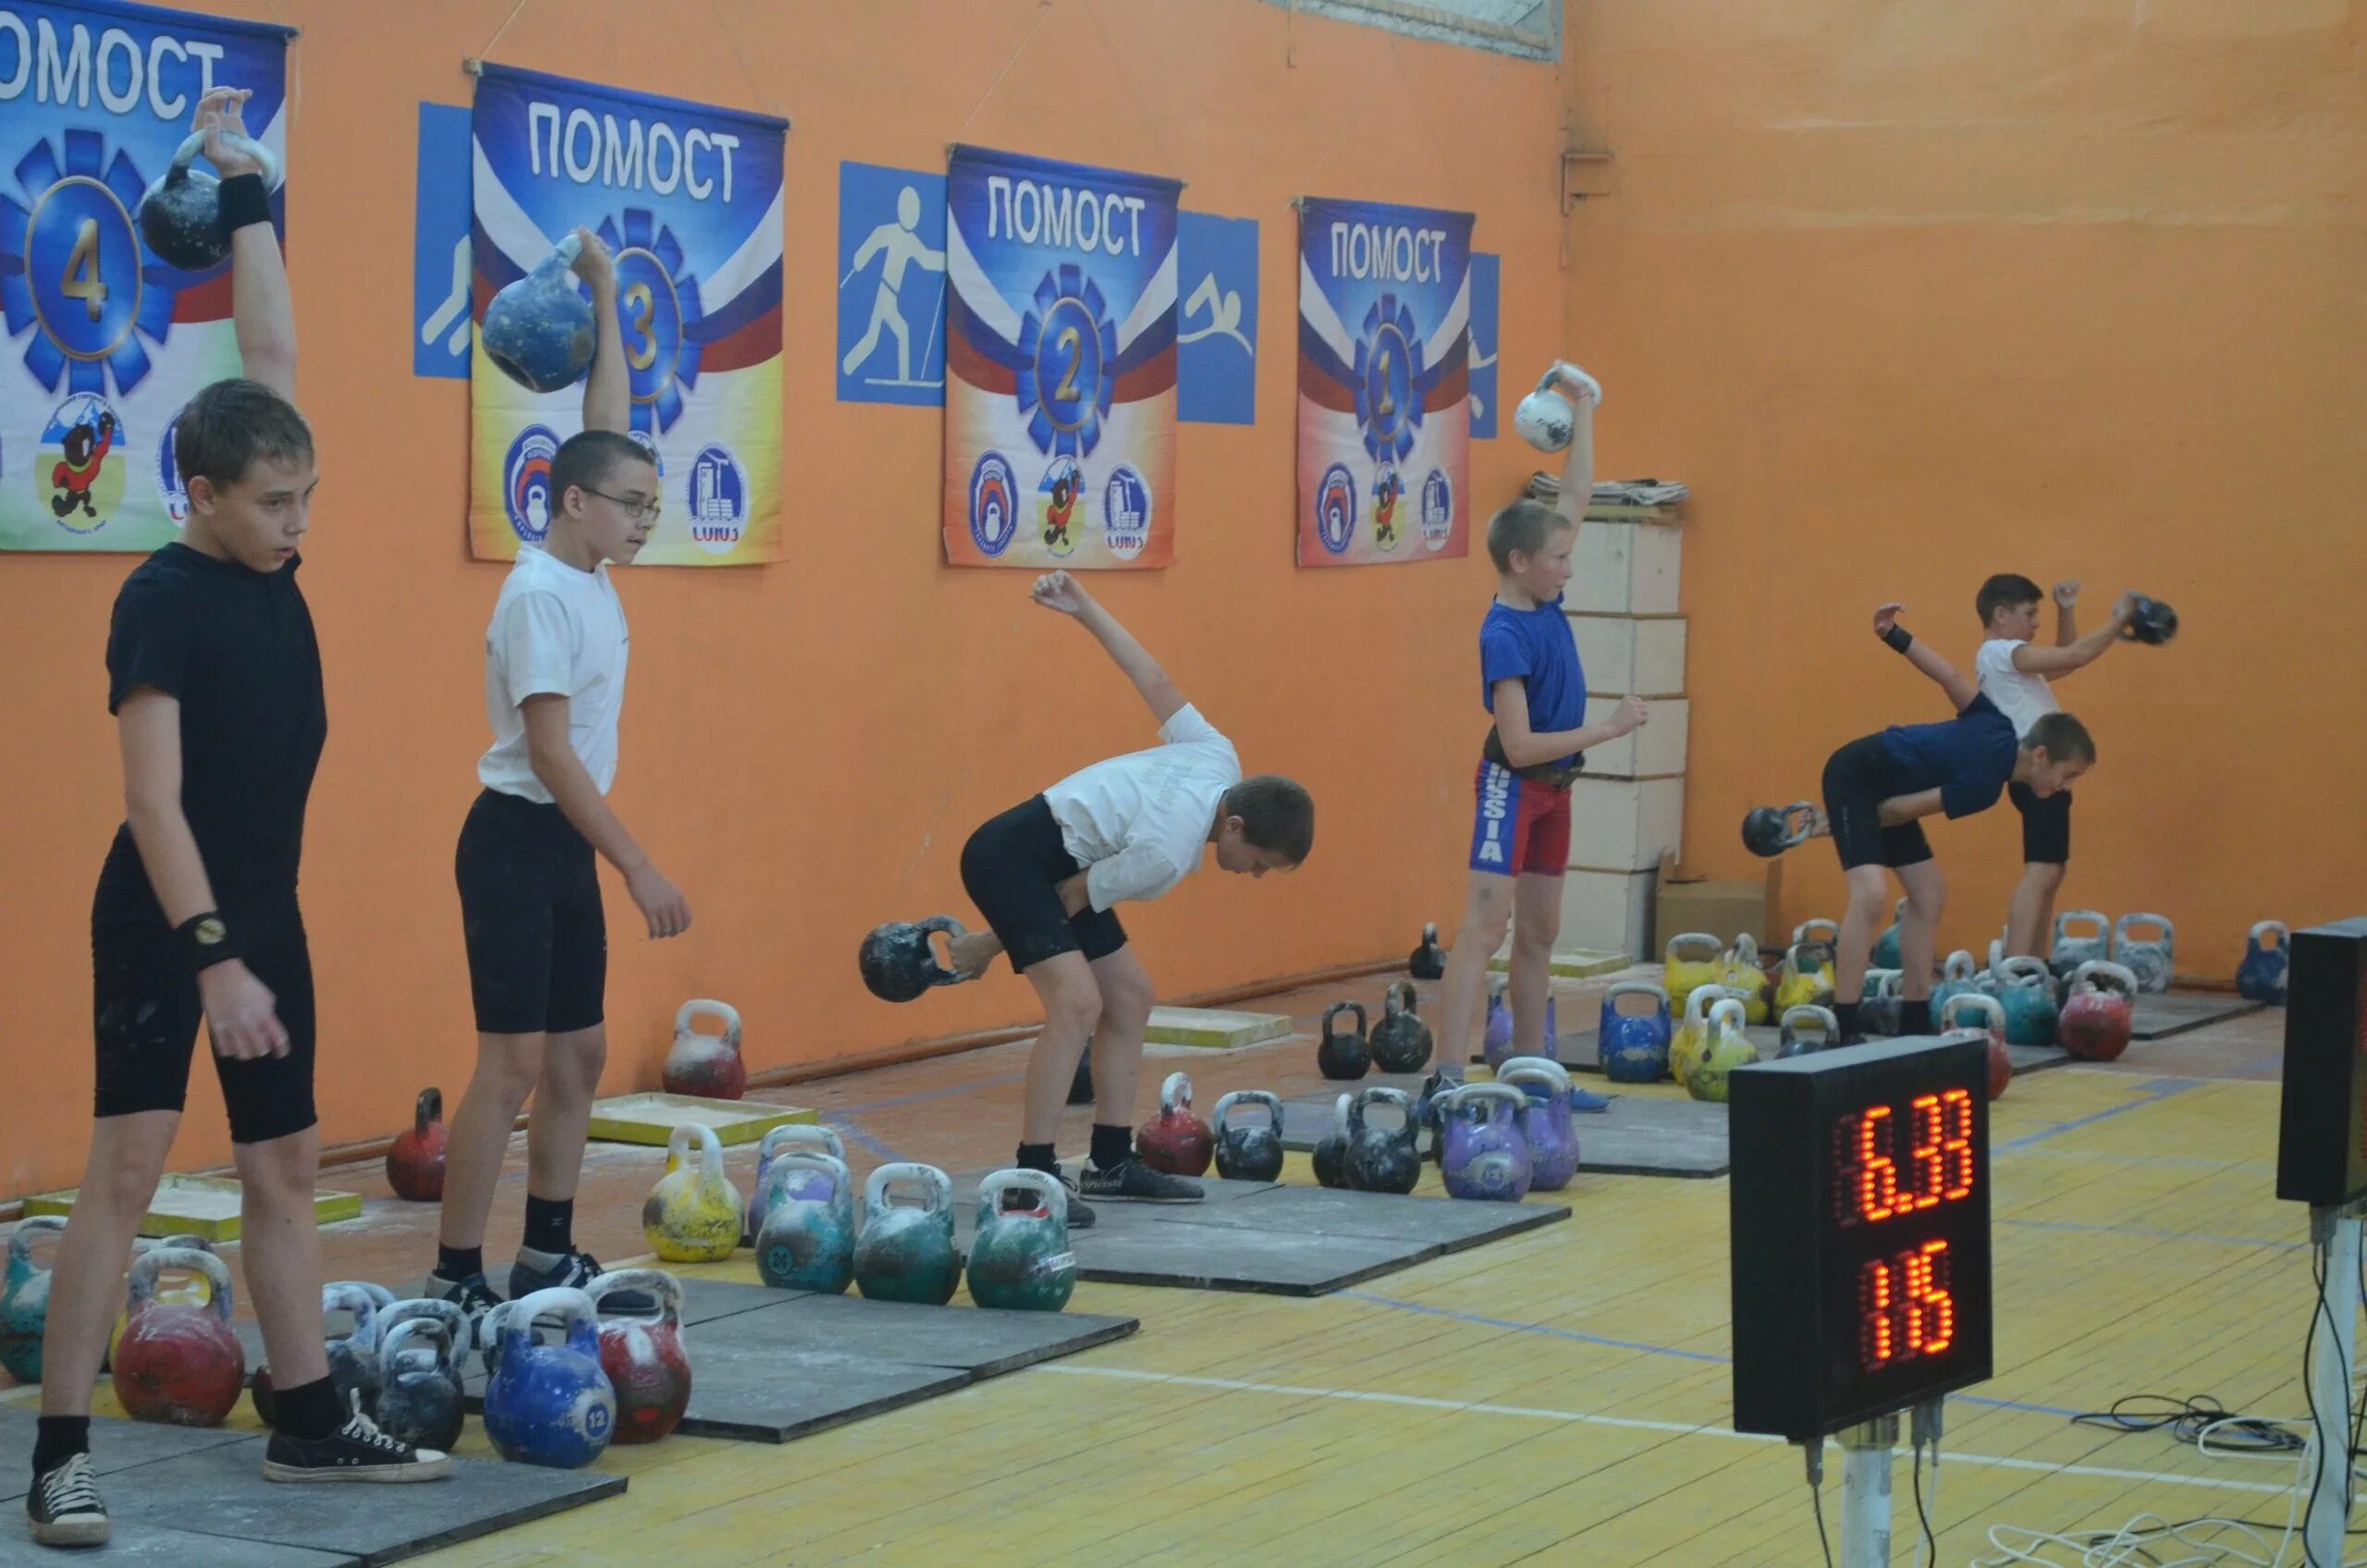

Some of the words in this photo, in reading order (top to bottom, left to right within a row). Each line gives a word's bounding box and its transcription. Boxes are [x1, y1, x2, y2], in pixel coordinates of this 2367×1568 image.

[0, 10, 224, 120] ОМОСТ
[528, 101, 741, 203] ПОМОСТ
[987, 175, 1146, 258] ПОМОСТ
[1331, 222, 1447, 284] ПОМОСТ
[60, 218, 108, 322] 4
[623, 281, 658, 371] 3
[1055, 326, 1082, 401] 2
[1379, 349, 1394, 415] 1
[1478, 762, 1512, 863] USSIA
[1874, 1240, 1953, 1359] 115
[589, 1410, 607, 1428] 12
